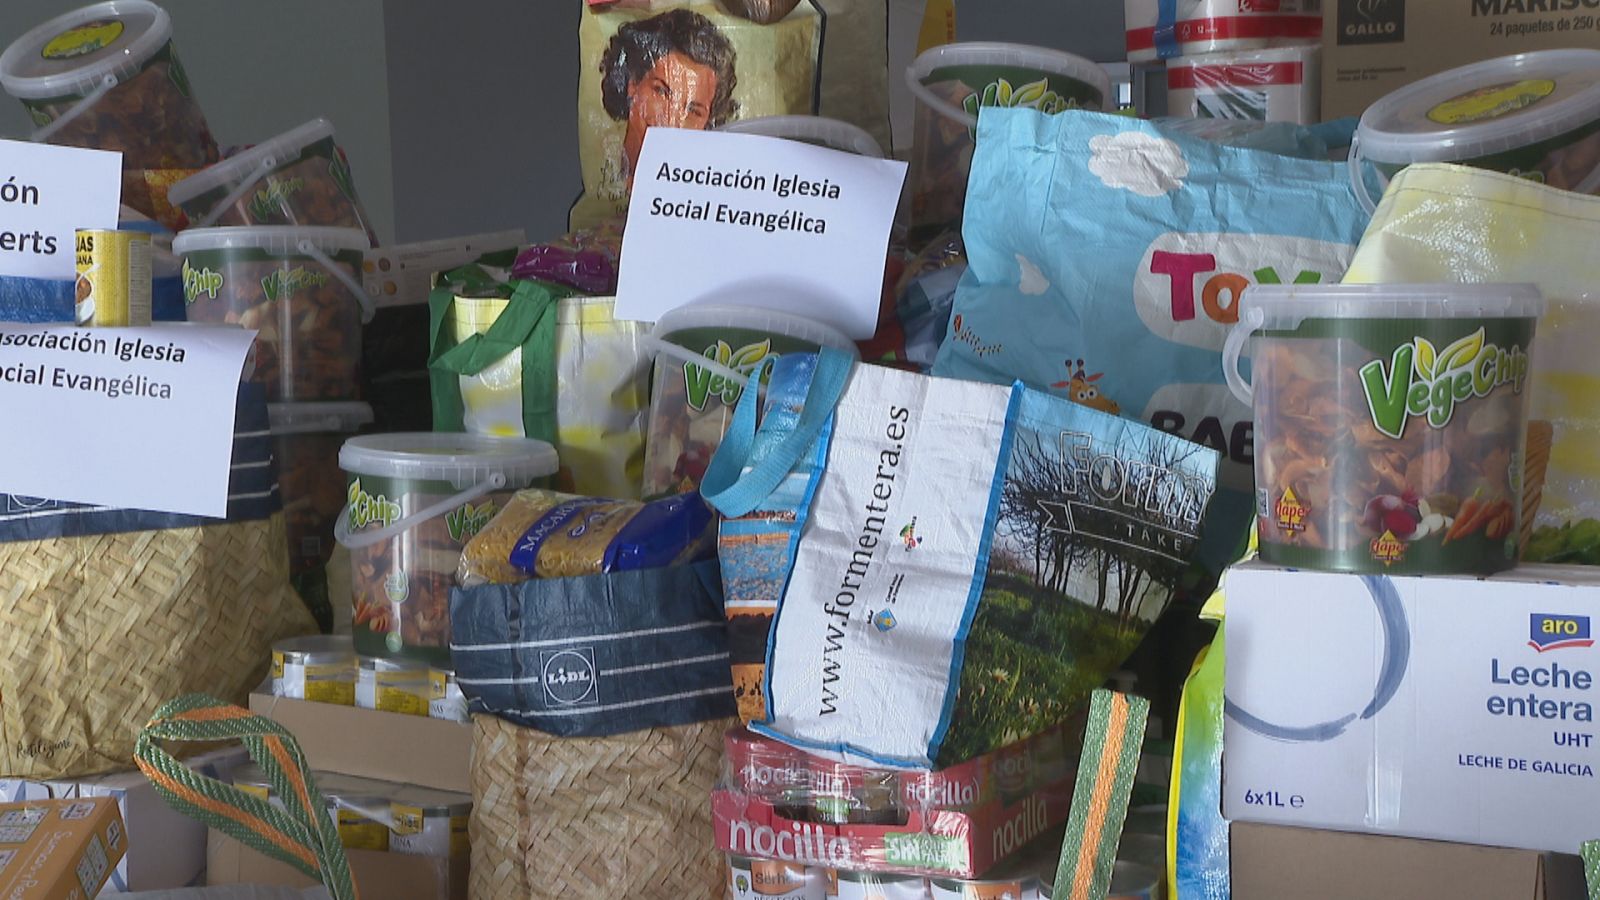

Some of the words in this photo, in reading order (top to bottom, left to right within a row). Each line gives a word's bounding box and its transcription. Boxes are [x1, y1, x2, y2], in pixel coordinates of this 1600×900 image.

[1346, 22, 1396, 36] GALLO
[1490, 22, 1503, 36] 24
[1506, 19, 1554, 38] paquetes
[1557, 18, 1570, 31] de
[1573, 15, 1593, 31] 250
[656, 162, 766, 191] Asociación
[773, 173, 841, 200] Iglesia
[650, 197, 711, 221] Social
[715, 204, 827, 235] Evangélica
[0, 330, 106, 354] sociación
[114, 337, 186, 363] Iglesia
[52, 367, 171, 399] Evangélica
[1360, 342, 1529, 439] VegeChip
[1126, 524, 1182, 551] TAKE
[819, 405, 910, 717] www.formentera.es
[1542, 618, 1578, 635] aro
[1491, 658, 1592, 690] Leche
[1487, 693, 1592, 722] entera
[1553, 731, 1593, 748] UHT
[1459, 753, 1503, 769] LECHE
[1508, 758, 1527, 771] DE
[1532, 760, 1594, 777] GALICIA
[1244, 789, 1285, 808] 6x1L
[729, 819, 851, 864] nocilla
[992, 793, 1048, 861] nocilla
